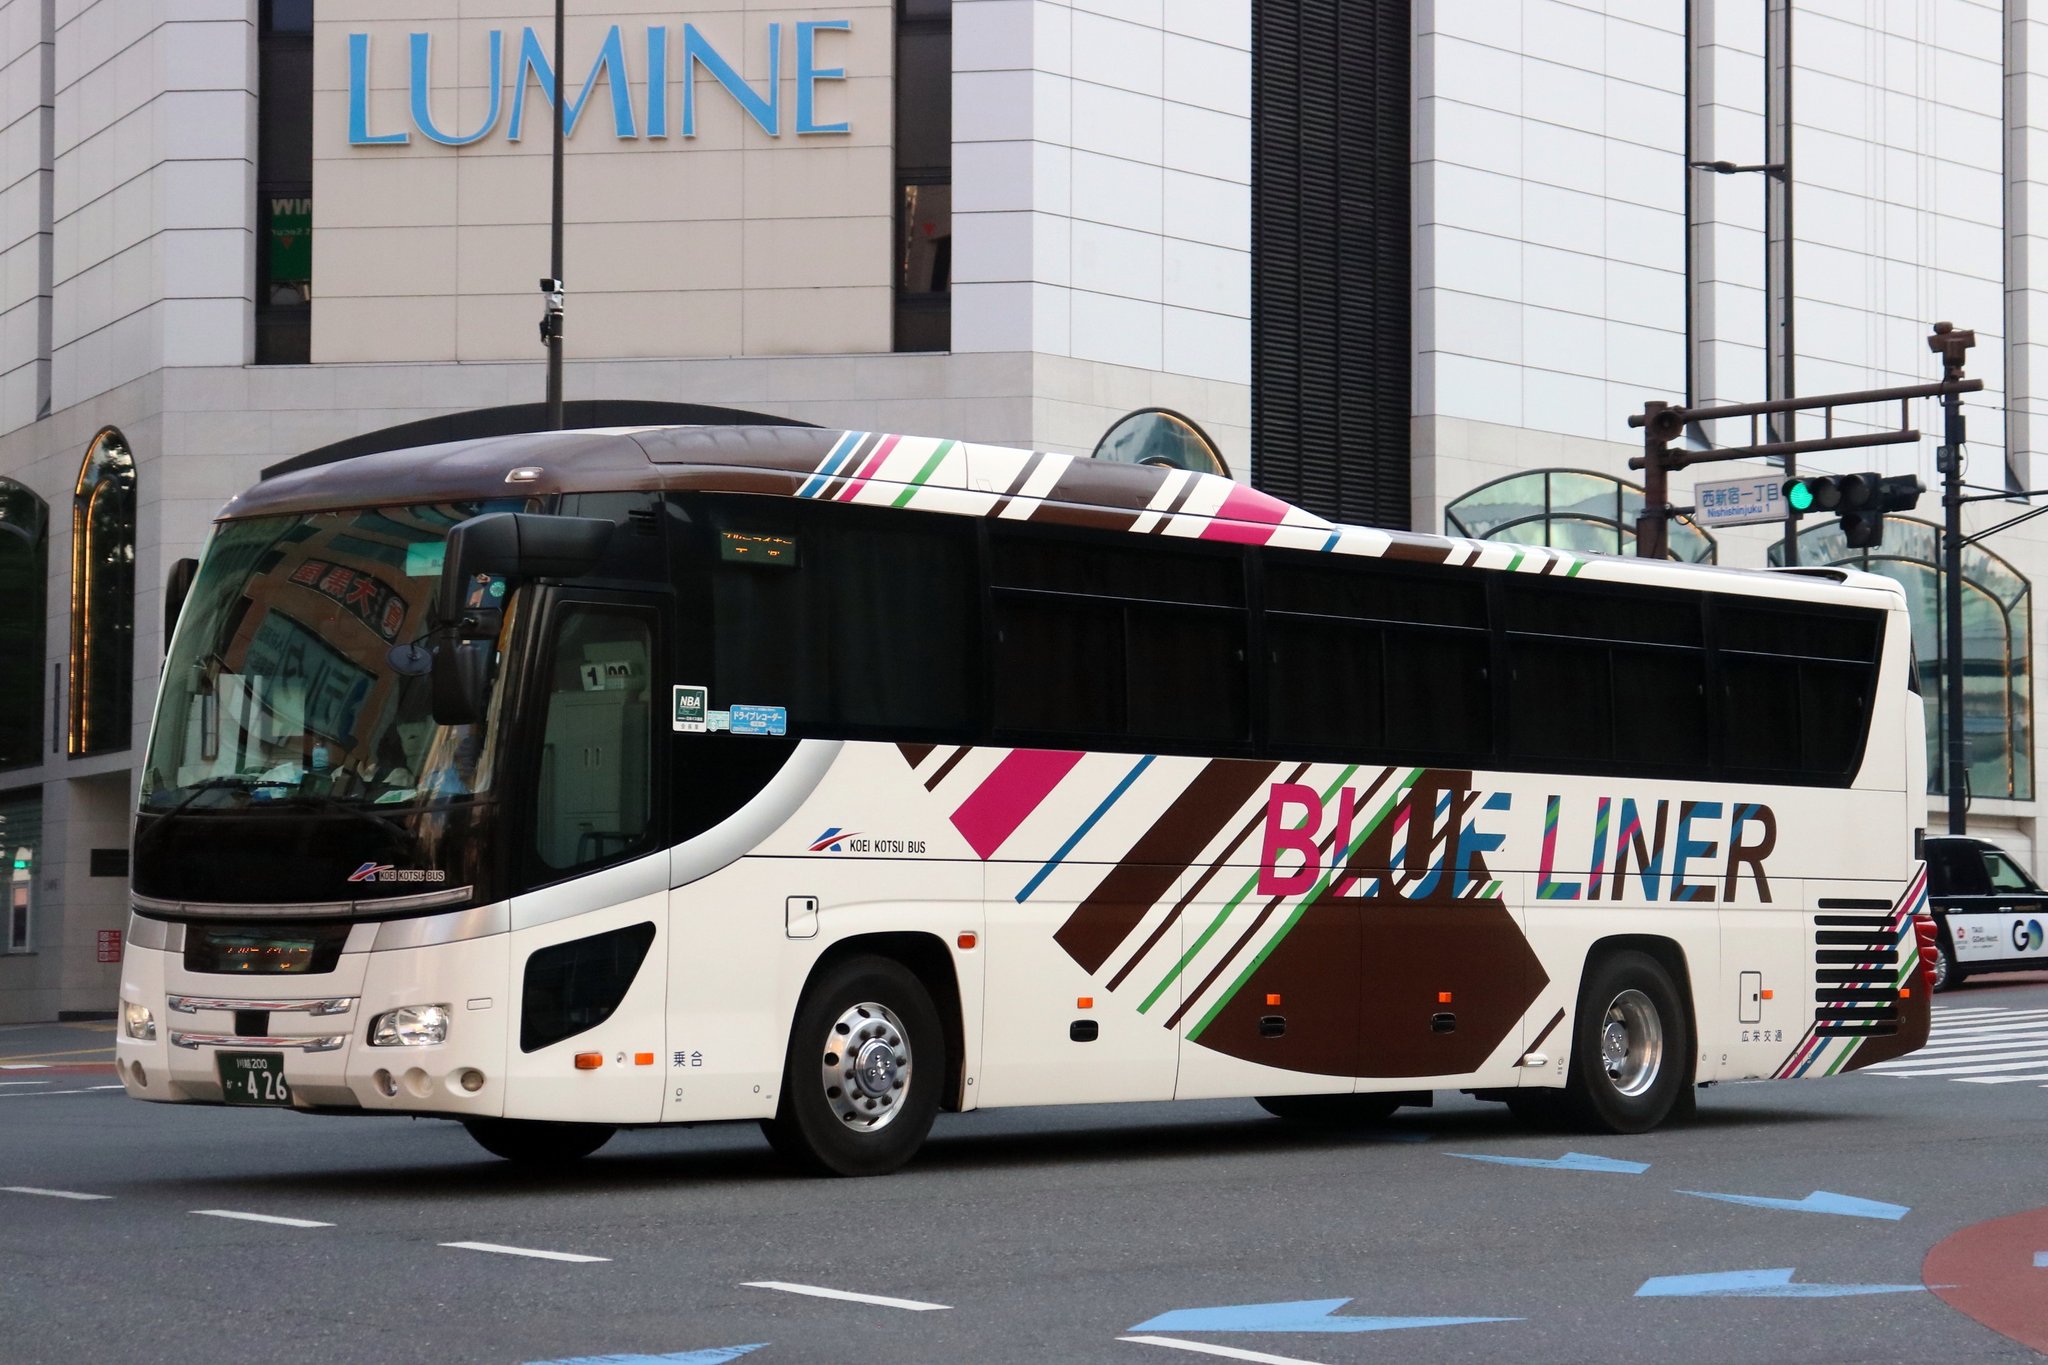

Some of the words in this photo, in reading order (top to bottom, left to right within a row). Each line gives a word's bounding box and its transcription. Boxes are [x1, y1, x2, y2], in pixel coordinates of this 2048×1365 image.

[347, 19, 853, 146] LUMINE
[1701, 483, 1779, 507] 西新宿一丁目
[1707, 504, 1763, 518] Nishishinjuku
[1765, 502, 1771, 513] 1
[680, 696, 701, 707] NBA
[733, 711, 783, 722] ドライブレコーダー
[849, 839, 871, 853] KOEI
[874, 840, 904, 854] KOTSU
[907, 840, 926, 854] BUS
[1257, 783, 1512, 900] BLUE
[1536, 794, 1778, 904] LINER
[379, 869, 397, 881] KOEI
[398, 869, 425, 881] KOTSU
[426, 869, 445, 881] BUS
[2012, 919, 2044, 952] GO
[1741, 1029, 1783, 1042] 広栄交通
[673, 1050, 702, 1067] 乗合
